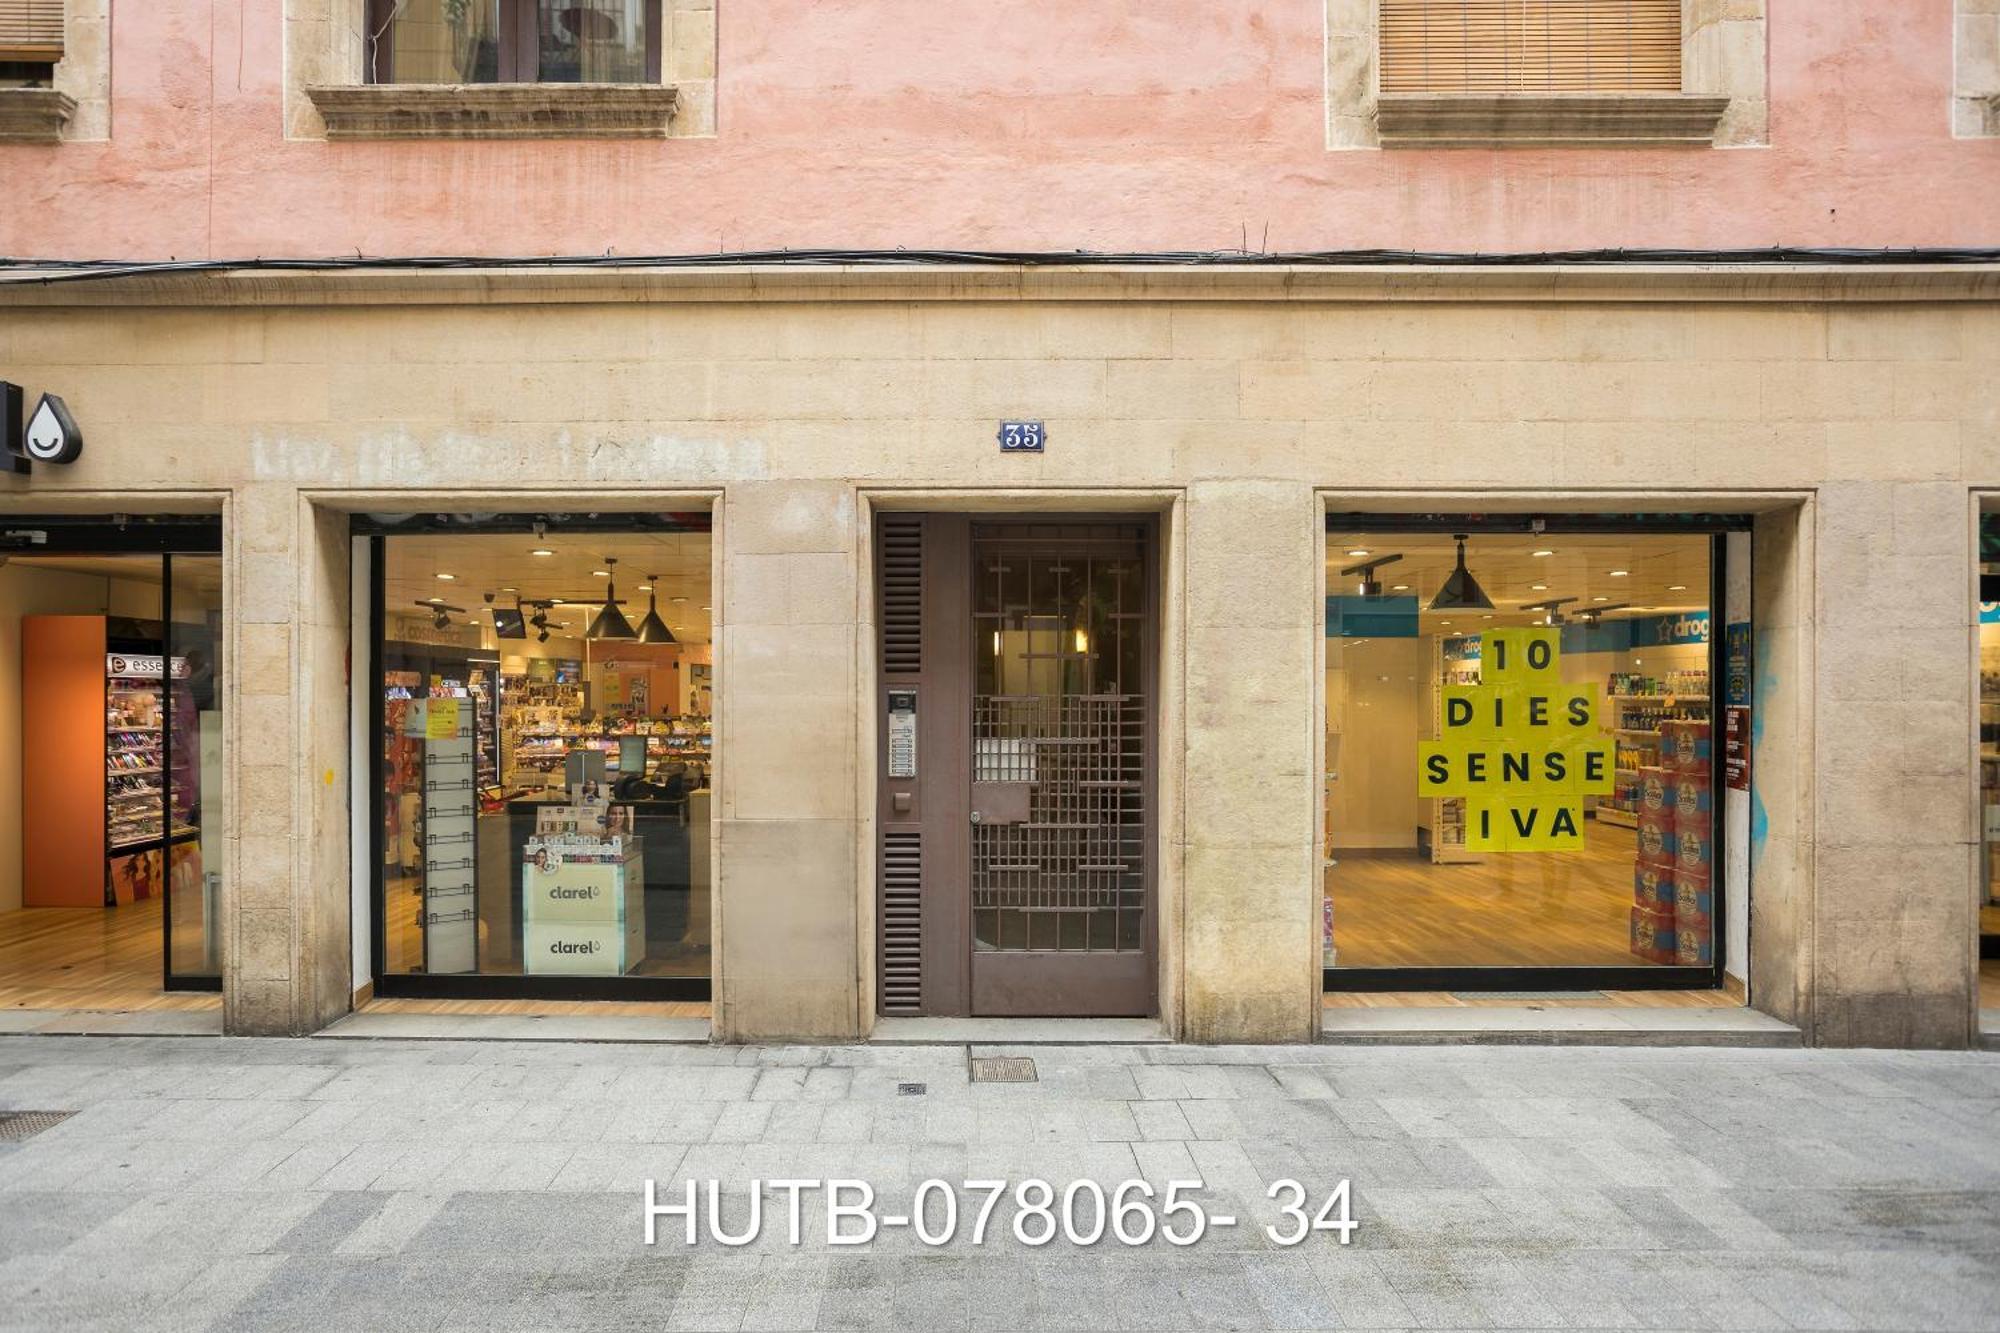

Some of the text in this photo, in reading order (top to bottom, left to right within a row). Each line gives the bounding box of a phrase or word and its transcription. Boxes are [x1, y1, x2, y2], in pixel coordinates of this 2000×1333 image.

[1005, 424, 1039, 448] 35
[133, 659, 185, 672] essece
[1492, 639, 1551, 670] 10
[1447, 696, 1590, 727] DIES
[1427, 751, 1605, 785] SENSE
[1481, 808, 1578, 839] IVA
[549, 885, 593, 900] clarel
[550, 940, 593, 955] clarel
